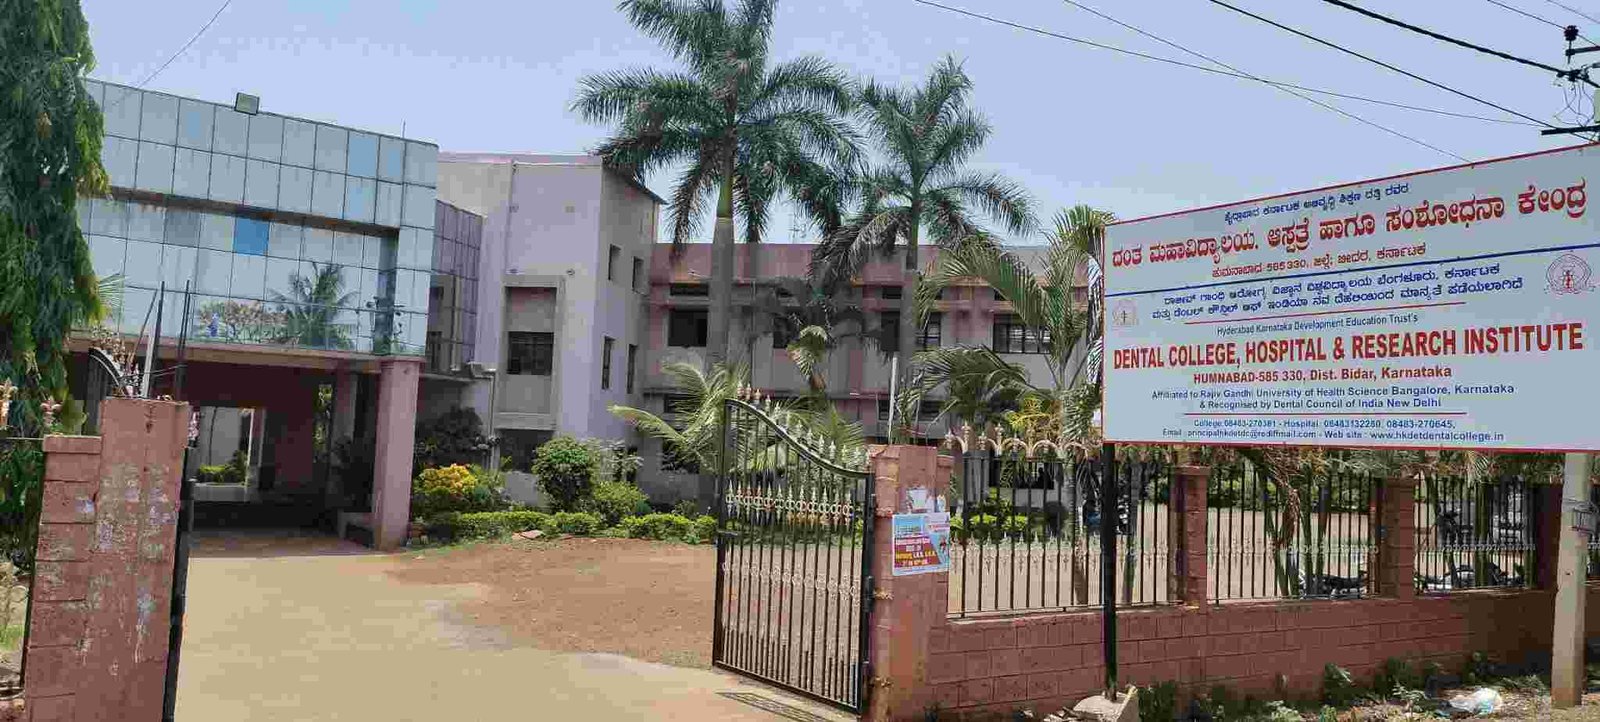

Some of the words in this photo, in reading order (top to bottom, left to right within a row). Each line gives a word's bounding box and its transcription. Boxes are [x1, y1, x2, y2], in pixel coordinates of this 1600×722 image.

[1112, 244, 1142, 267] ದಂತ
[1267, 217, 1310, 252] ಆಸ್ಪತ್ರೆ
[1319, 212, 1376, 241] ಹಾಗೂ
[1385, 194, 1505, 229] ಸಂಶೋಧನಾ
[1517, 177, 1588, 219] ಕೇಂದ್ರ
[1376, 243, 1426, 260] ಕರ್ನಾಟಕ
[1444, 263, 1500, 279] ಕರ್ನಾಟಕ
[1400, 283, 1442, 301] ಮಾನ್ಯತೆ
[1449, 277, 1523, 295] ಪಡೆಯಲಾಗಿದೆ
[1217, 323, 1255, 337] Hyderabad
[1256, 321, 1293, 334] Karnataka
[1294, 317, 1344, 333] Development
[1346, 315, 1387, 328] Education
[1389, 313, 1418, 324] Trust's
[1114, 347, 1164, 369] DENTAL
[1169, 342, 1241, 369] COLLEGE,
[1246, 337, 1327, 363] HOSPITAL
[1333, 336, 1345, 360] &
[1352, 329, 1456, 359] RESEARCH
[1464, 323, 1583, 354] INSTITUTE
[1193, 372, 1278, 385] HUMNABAD-585
[1283, 371, 1306, 384] 330,
[1310, 369, 1337, 381] Dist.
[1341, 367, 1377, 381] Bidar,
[1381, 365, 1452, 380] Karnataka
[1152, 390, 1188, 399] Affiliated
[1190, 390, 1199, 399] to
[1201, 389, 1221, 400] Rajiv
[1223, 388, 1252, 399] Gandhi
[1256, 387, 1302, 400] University
[1305, 387, 1314, 397] of
[1317, 386, 1345, 397] Health
[1348, 386, 1388, 397] Science
[1391, 384, 1451, 398] Bangalore,
[1455, 383, 1514, 395] Karnataka
[1199, 401, 1206, 410] &
[1208, 400, 1258, 411] Recognised
[1260, 400, 1271, 410] by
[1274, 399, 1303, 409] Dental
[1306, 398, 1343, 409] Council
[1346, 398, 1356, 408] of
[1358, 398, 1384, 409] India
[1387, 398, 1410, 409] New
[1413, 397, 1442, 408] Delhi
[1324, 430, 1344, 439] Web
